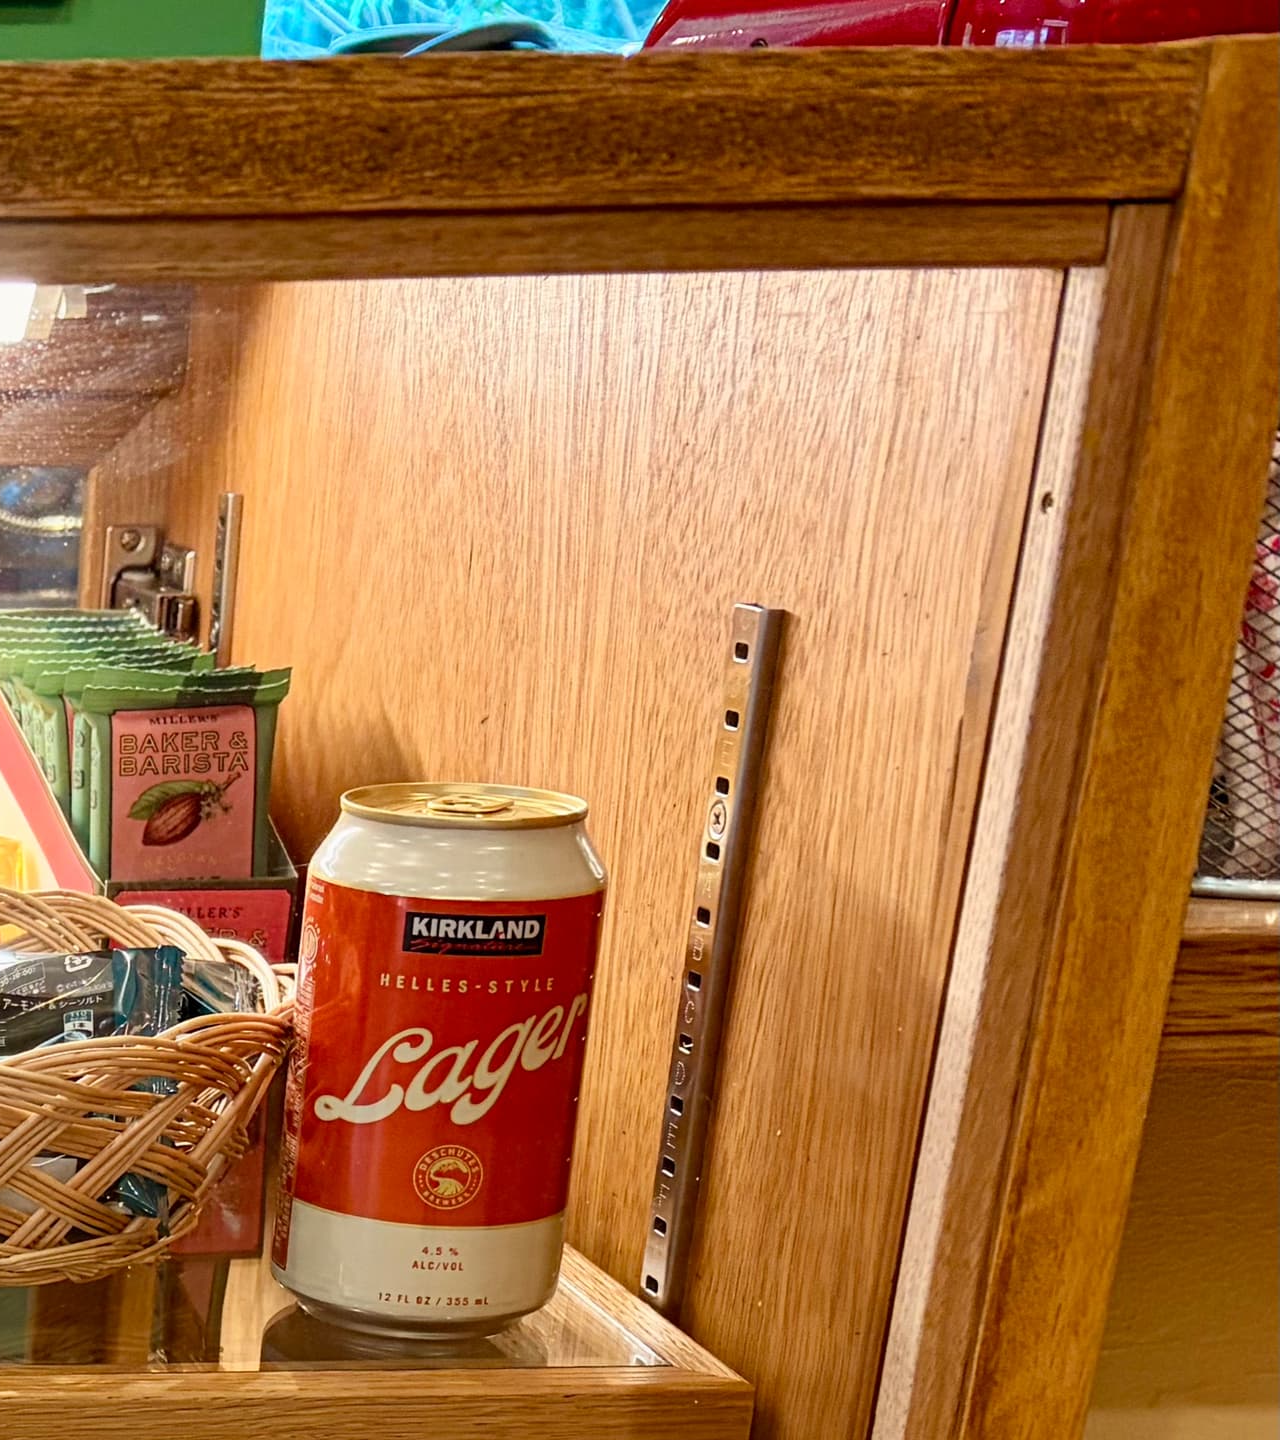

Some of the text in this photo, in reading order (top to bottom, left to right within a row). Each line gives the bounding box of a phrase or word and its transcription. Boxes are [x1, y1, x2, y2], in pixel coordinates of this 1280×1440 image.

[149, 713, 220, 725] MILLER'S
[119, 731, 249, 754] BAKER &
[119, 751, 249, 776] BARISTA
[411, 916, 540, 940] KIRKLAND
[379, 973, 555, 994] HELLES-STYLE
[314, 993, 588, 1125] Lager
[421, 1246, 459, 1257] 4.5 %
[411, 1260, 464, 1272] ALC/VOL
[378, 1291, 469, 1307] 12 FL OZ 355
